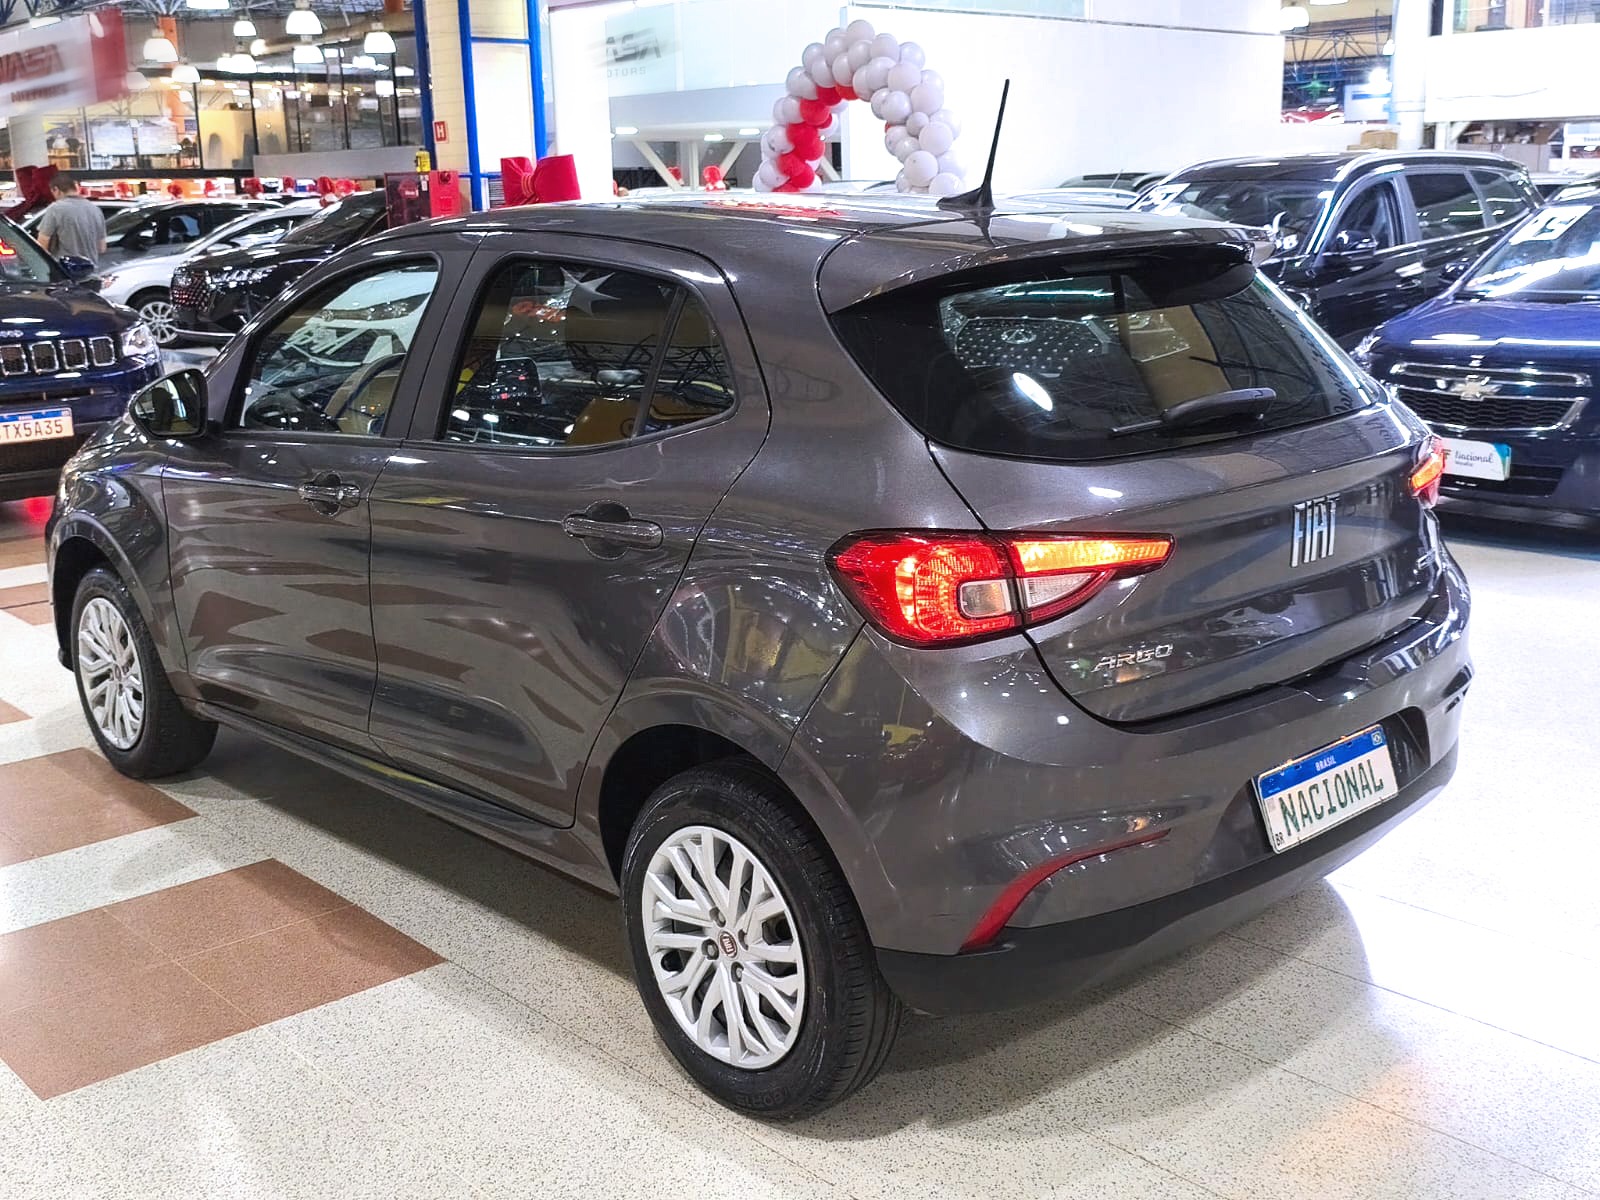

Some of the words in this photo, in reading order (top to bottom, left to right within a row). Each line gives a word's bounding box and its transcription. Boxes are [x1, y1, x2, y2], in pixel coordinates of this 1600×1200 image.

[437, 124, 445, 138] H
[0, 419, 63, 439] TX5A35
[1291, 492, 1341, 568] FIAT
[1091, 644, 1173, 672] ARGO
[1315, 755, 1337, 771] BRASIL
[1278, 758, 1384, 837] NACIONAL
